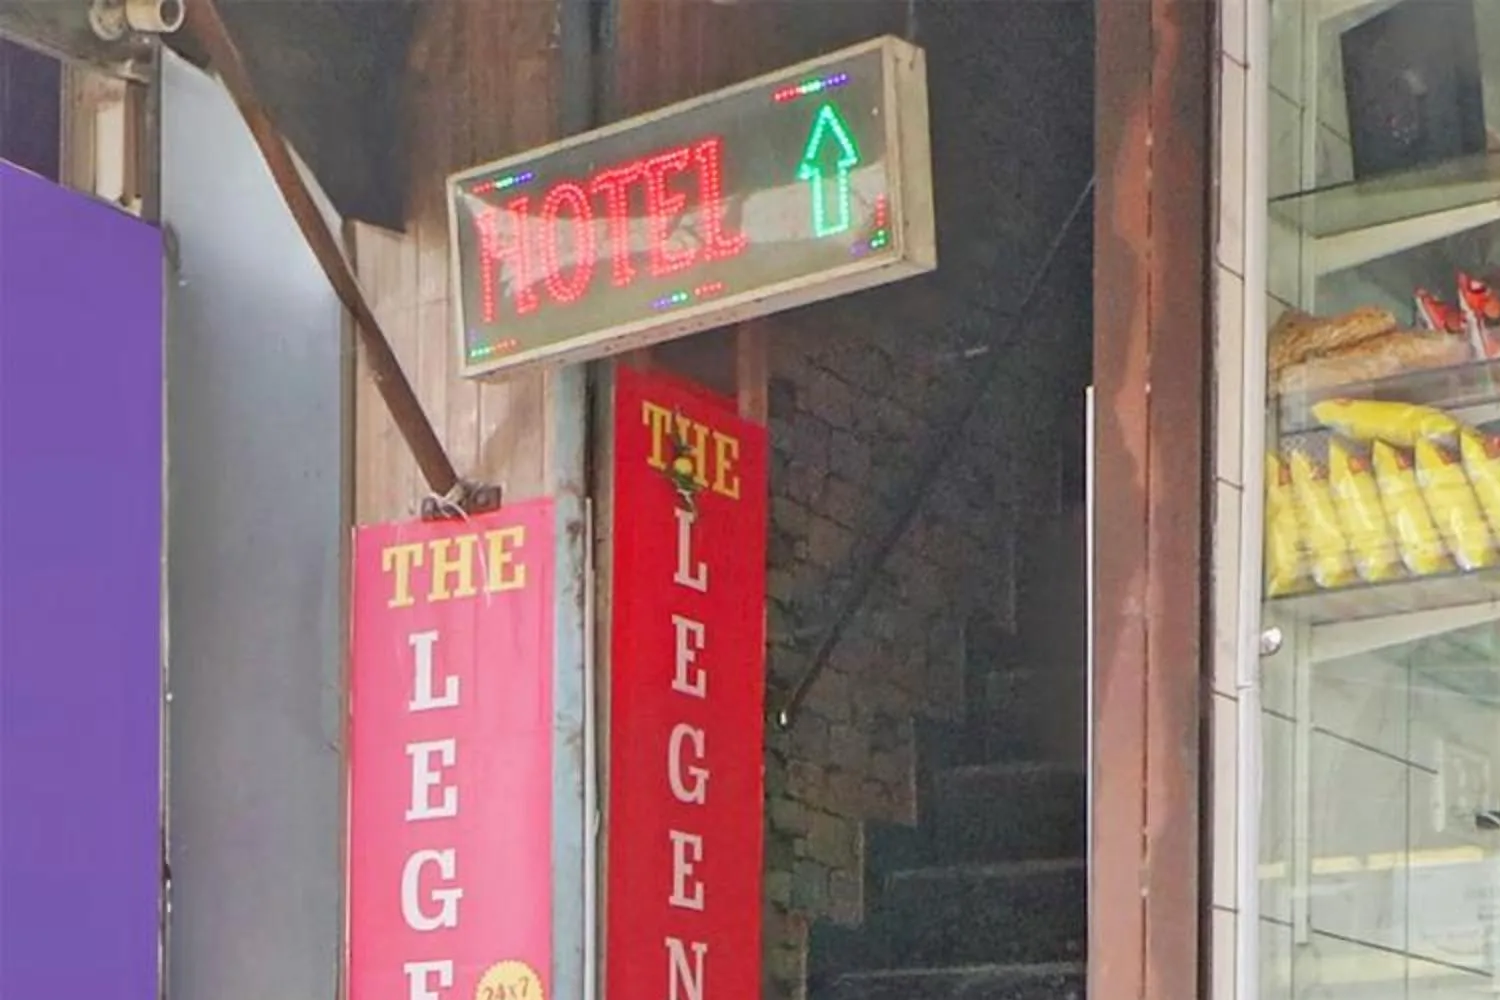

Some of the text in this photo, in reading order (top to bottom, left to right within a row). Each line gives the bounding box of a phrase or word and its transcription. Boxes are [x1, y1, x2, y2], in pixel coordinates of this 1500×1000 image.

[474, 135, 748, 322] HOTEL
[641, 400, 740, 500] THE
[382, 525, 526, 609] THE
